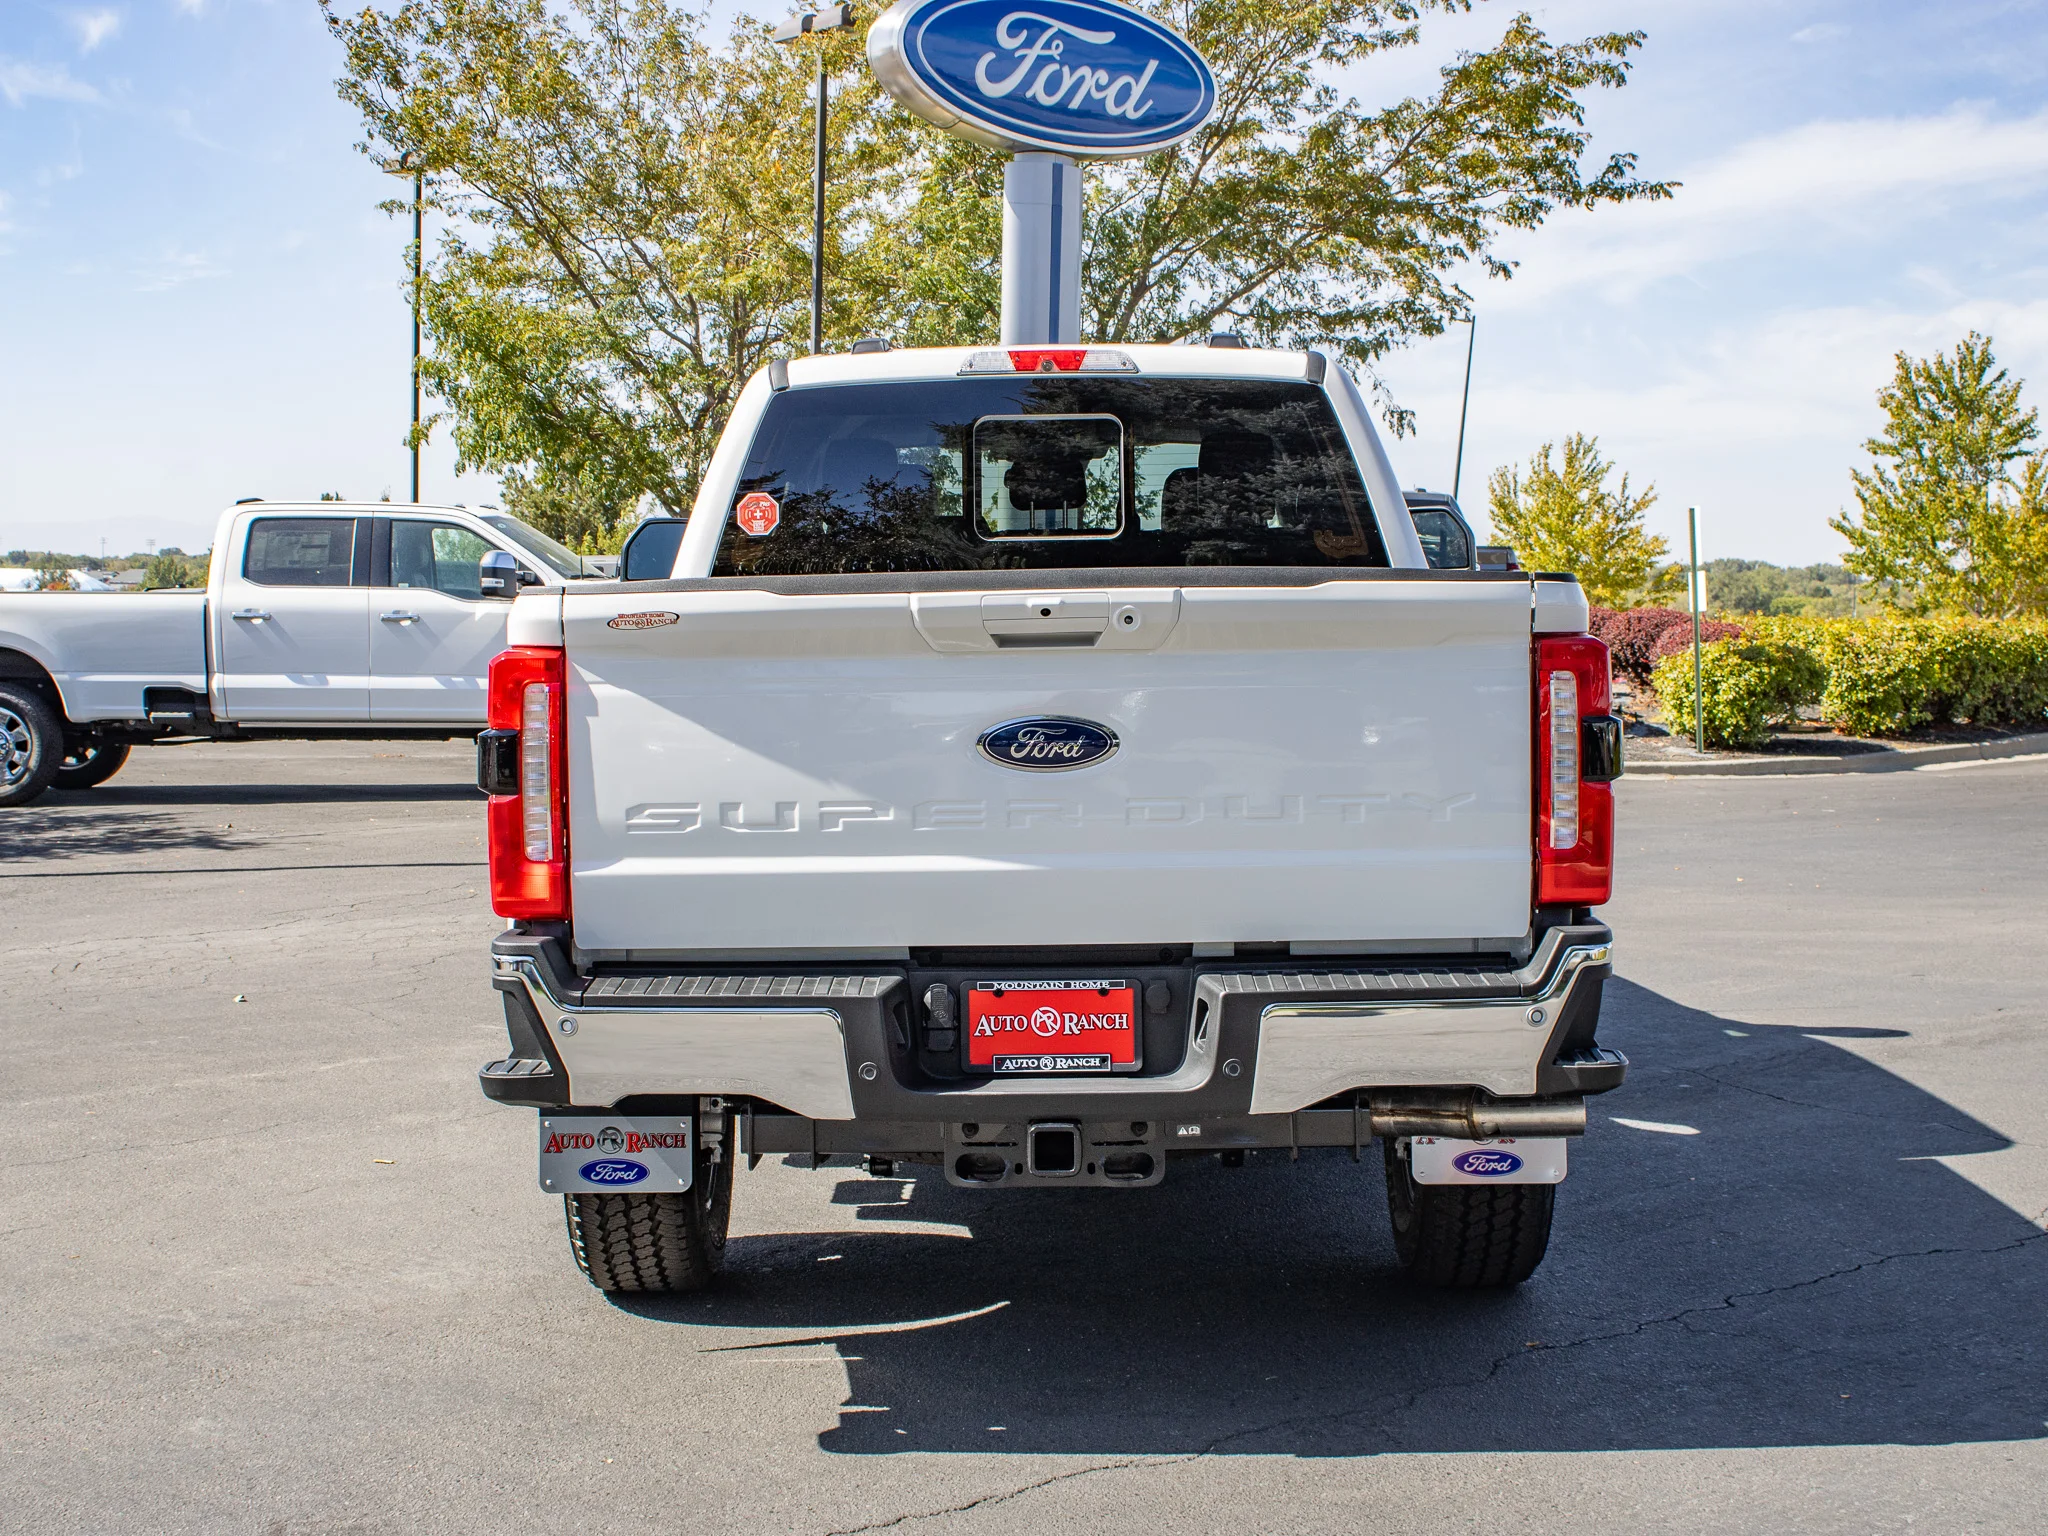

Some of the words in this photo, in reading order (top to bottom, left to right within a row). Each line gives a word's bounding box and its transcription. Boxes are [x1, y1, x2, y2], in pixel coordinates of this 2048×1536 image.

[975, 11, 1160, 120] Ford
[611, 619, 635, 628] AUTO
[645, 618, 678, 627] RANCH
[1010, 727, 1085, 759] Ford
[625, 800, 1083, 834] SUPER
[1125, 792, 1477, 826] DUTY
[993, 981, 1064, 990] MOUNTAIN
[1070, 980, 1111, 989] HOME
[973, 1013, 1028, 1037] AUTO
[1062, 1012, 1129, 1035] RANCH
[1001, 1058, 1038, 1070] AUTO
[1055, 1057, 1101, 1069] RANCH
[543, 1132, 595, 1154] AUTO
[625, 1131, 687, 1154] RANCH
[590, 1163, 639, 1181] Ford
[1463, 1154, 1513, 1172] Ford
